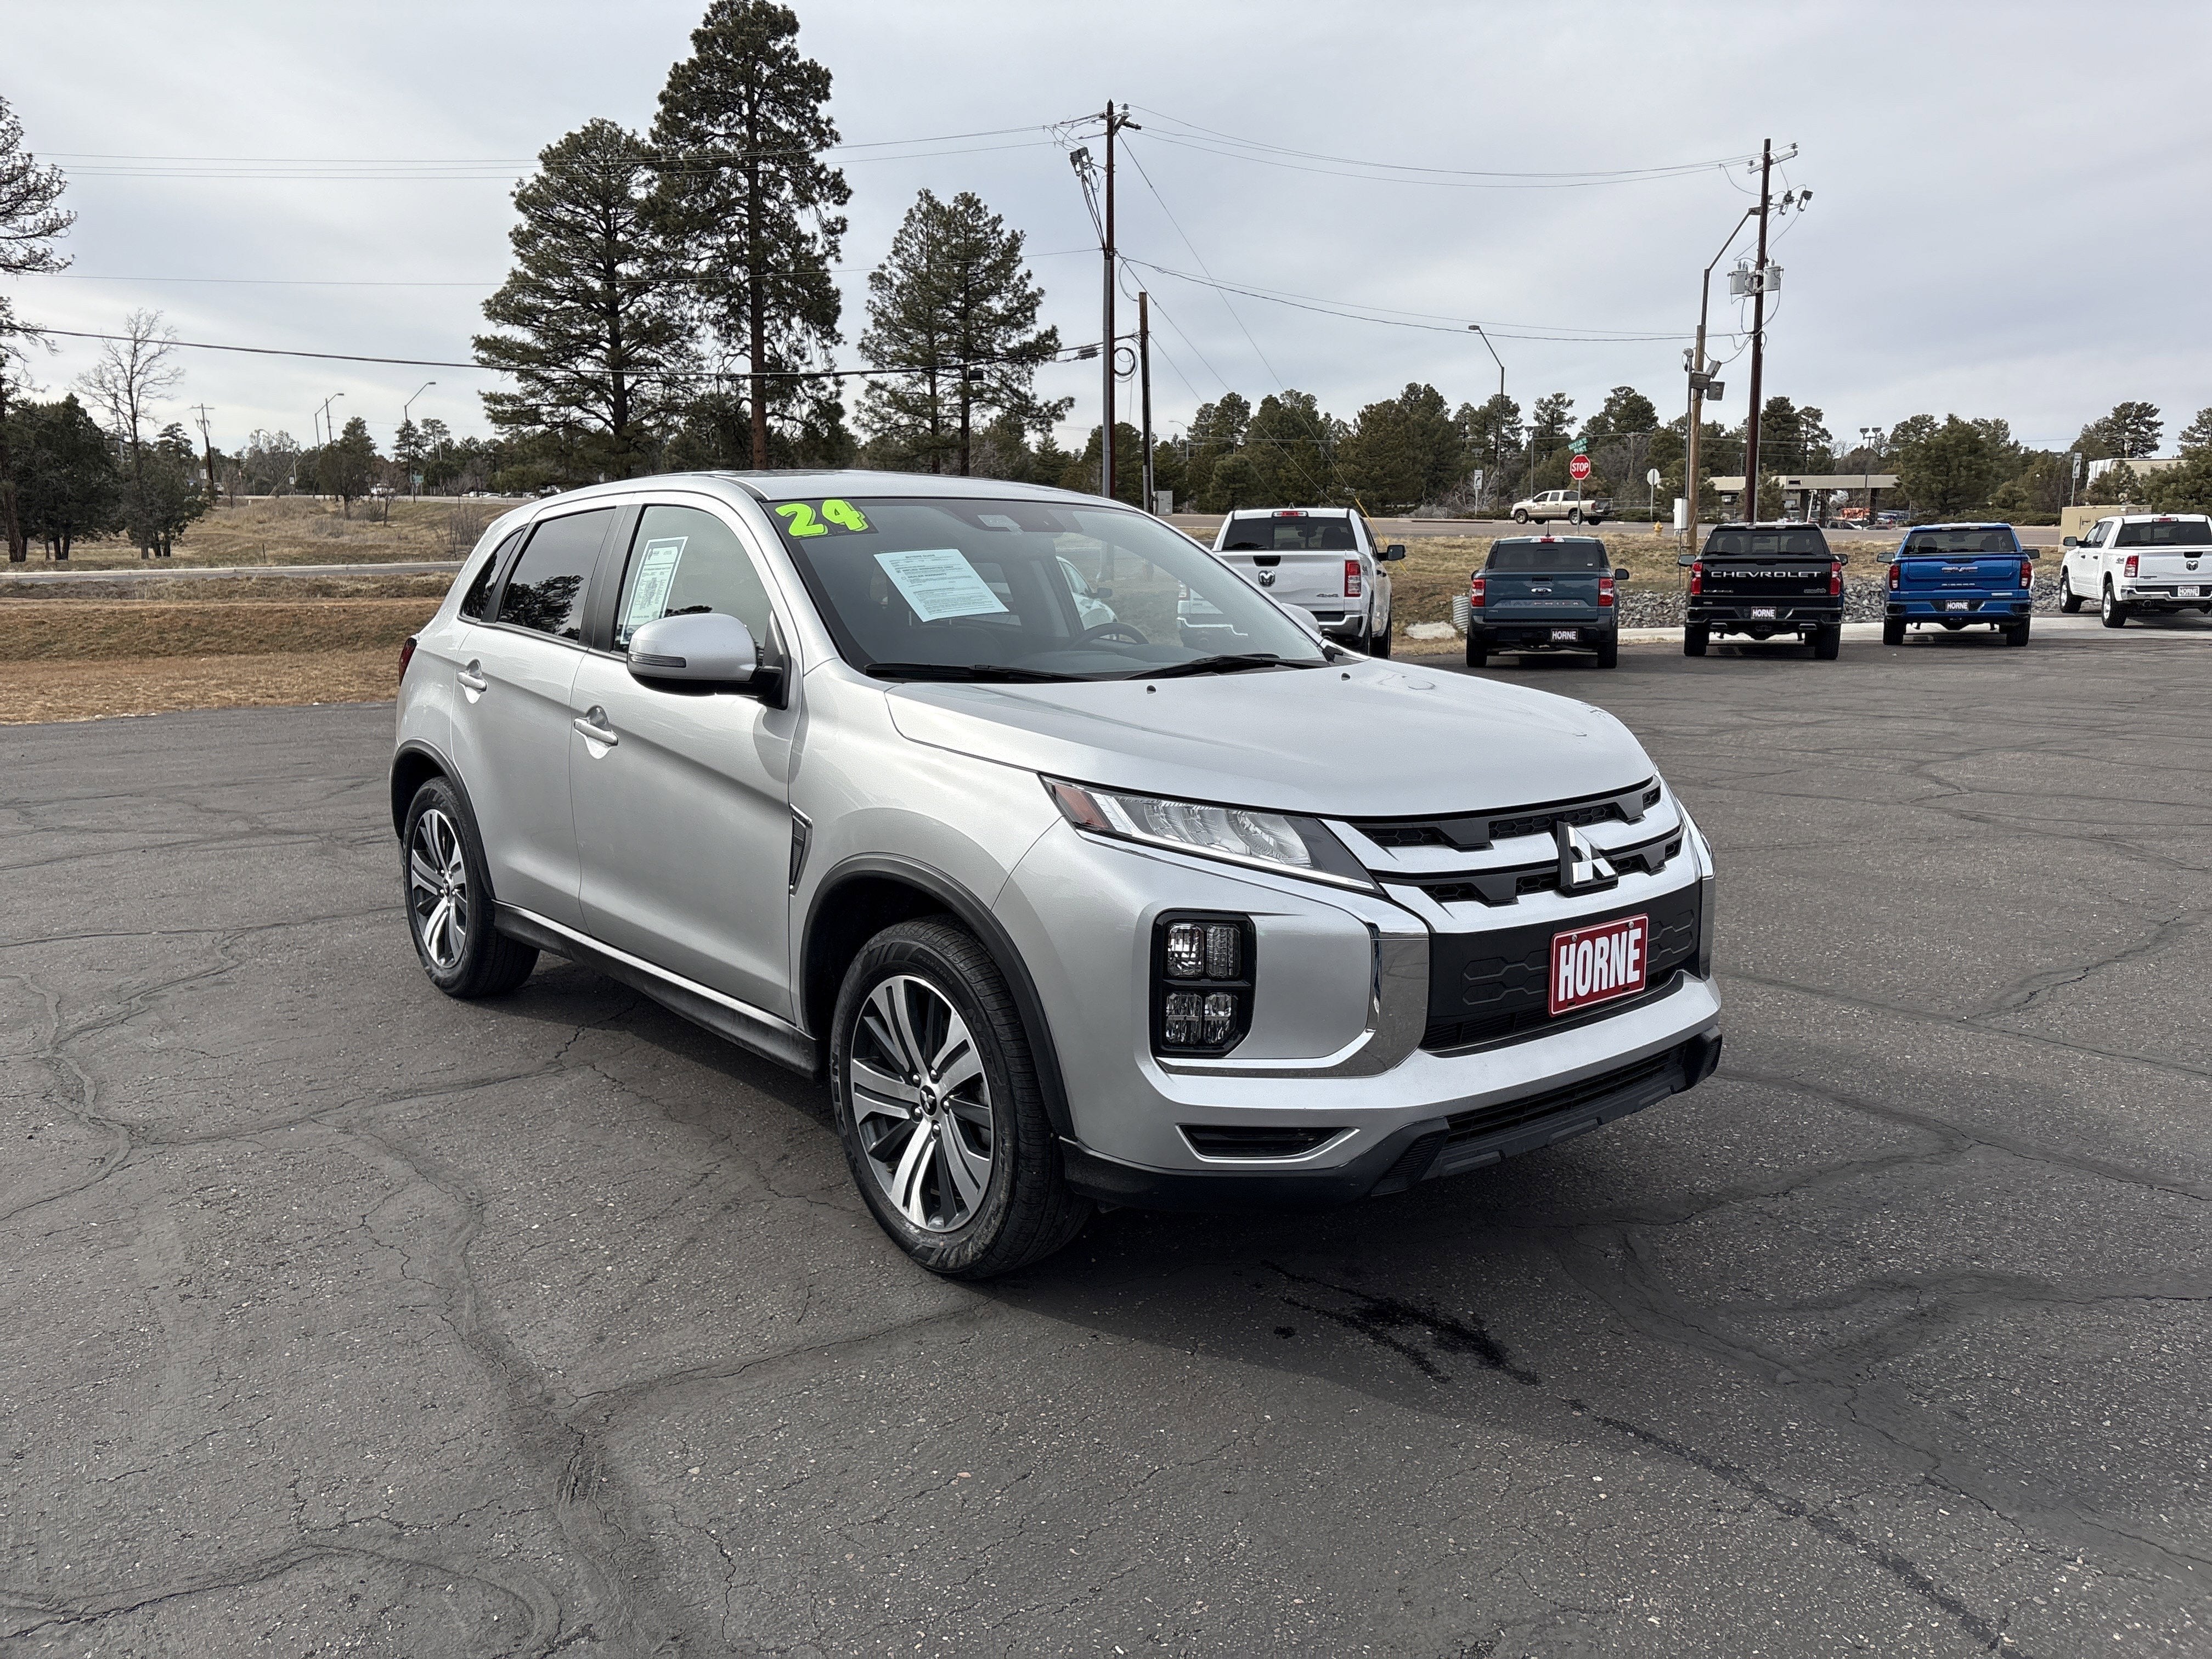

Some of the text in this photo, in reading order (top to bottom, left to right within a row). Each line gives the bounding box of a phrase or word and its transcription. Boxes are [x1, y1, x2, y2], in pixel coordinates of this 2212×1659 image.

[1572, 462, 1589, 472] STOP
[775, 499, 869, 537] 24
[1752, 609, 1775, 617] HORNE
[1551, 631, 1577, 640] HORNE
[1558, 928, 1642, 1002] HORNE
